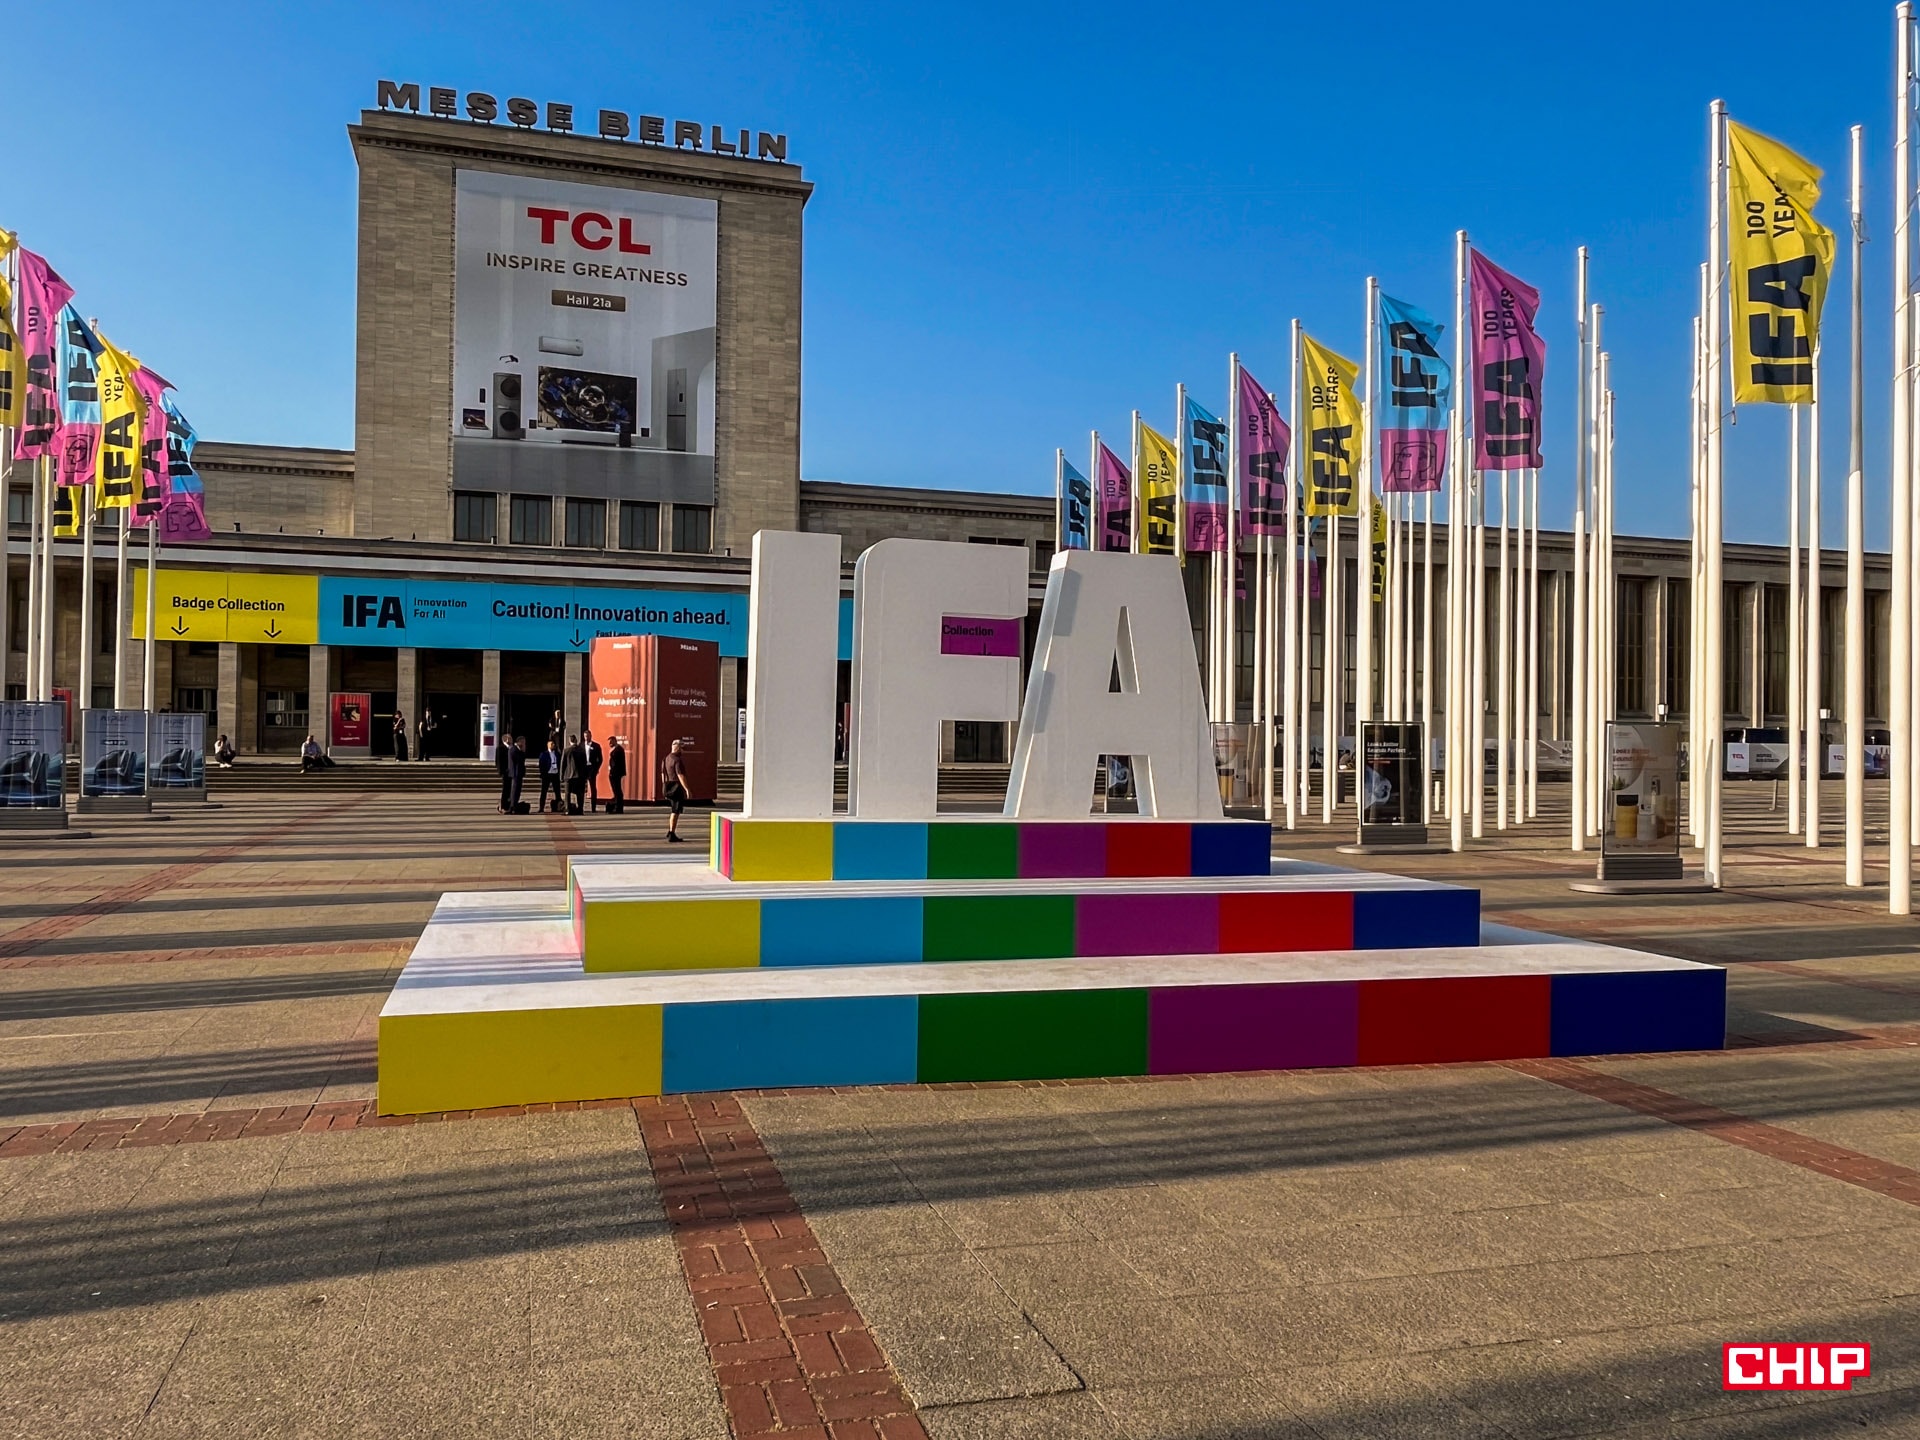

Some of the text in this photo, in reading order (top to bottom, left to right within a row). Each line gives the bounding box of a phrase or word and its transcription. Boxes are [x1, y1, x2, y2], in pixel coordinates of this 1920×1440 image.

[378, 80, 786, 160] MESSE BERLIN
[527, 207, 651, 255] TCL
[1746, 201, 1766, 238] 100
[486, 252, 688, 286] INSPIRE GREATNESS
[28, 306, 39, 336] 100
[566, 294, 612, 308] Hall 21a
[1501, 287, 1517, 340] YEARS
[1748, 255, 1816, 385] IFA
[1484, 311, 1499, 340] 100
[67, 319, 100, 402] IFA
[1389, 321, 1440, 409] IFA
[1312, 385, 1323, 410] 100
[1326, 366, 1339, 411] YEARS
[1484, 357, 1534, 457] IFA
[166, 412, 192, 476] IFA
[1249, 414, 1258, 437] 100
[104, 411, 135, 496] IFA
[1148, 464, 1158, 483] 100
[1194, 420, 1226, 486] IFA
[1312, 425, 1352, 506] IFA
[137, 438, 163, 516] IFA
[1107, 480, 1115, 498] 100
[1249, 451, 1285, 527] IFA
[1068, 479, 1097, 536] IFA
[172, 596, 285, 612] Badge Collection
[343, 594, 406, 629] IFA
[414, 597, 468, 608] Innovation
[414, 609, 446, 619] For All
[492, 600, 731, 626] Caution! Innovation ahead.
[943, 624, 994, 637] Collection
[747, 530, 1224, 818] IFA
